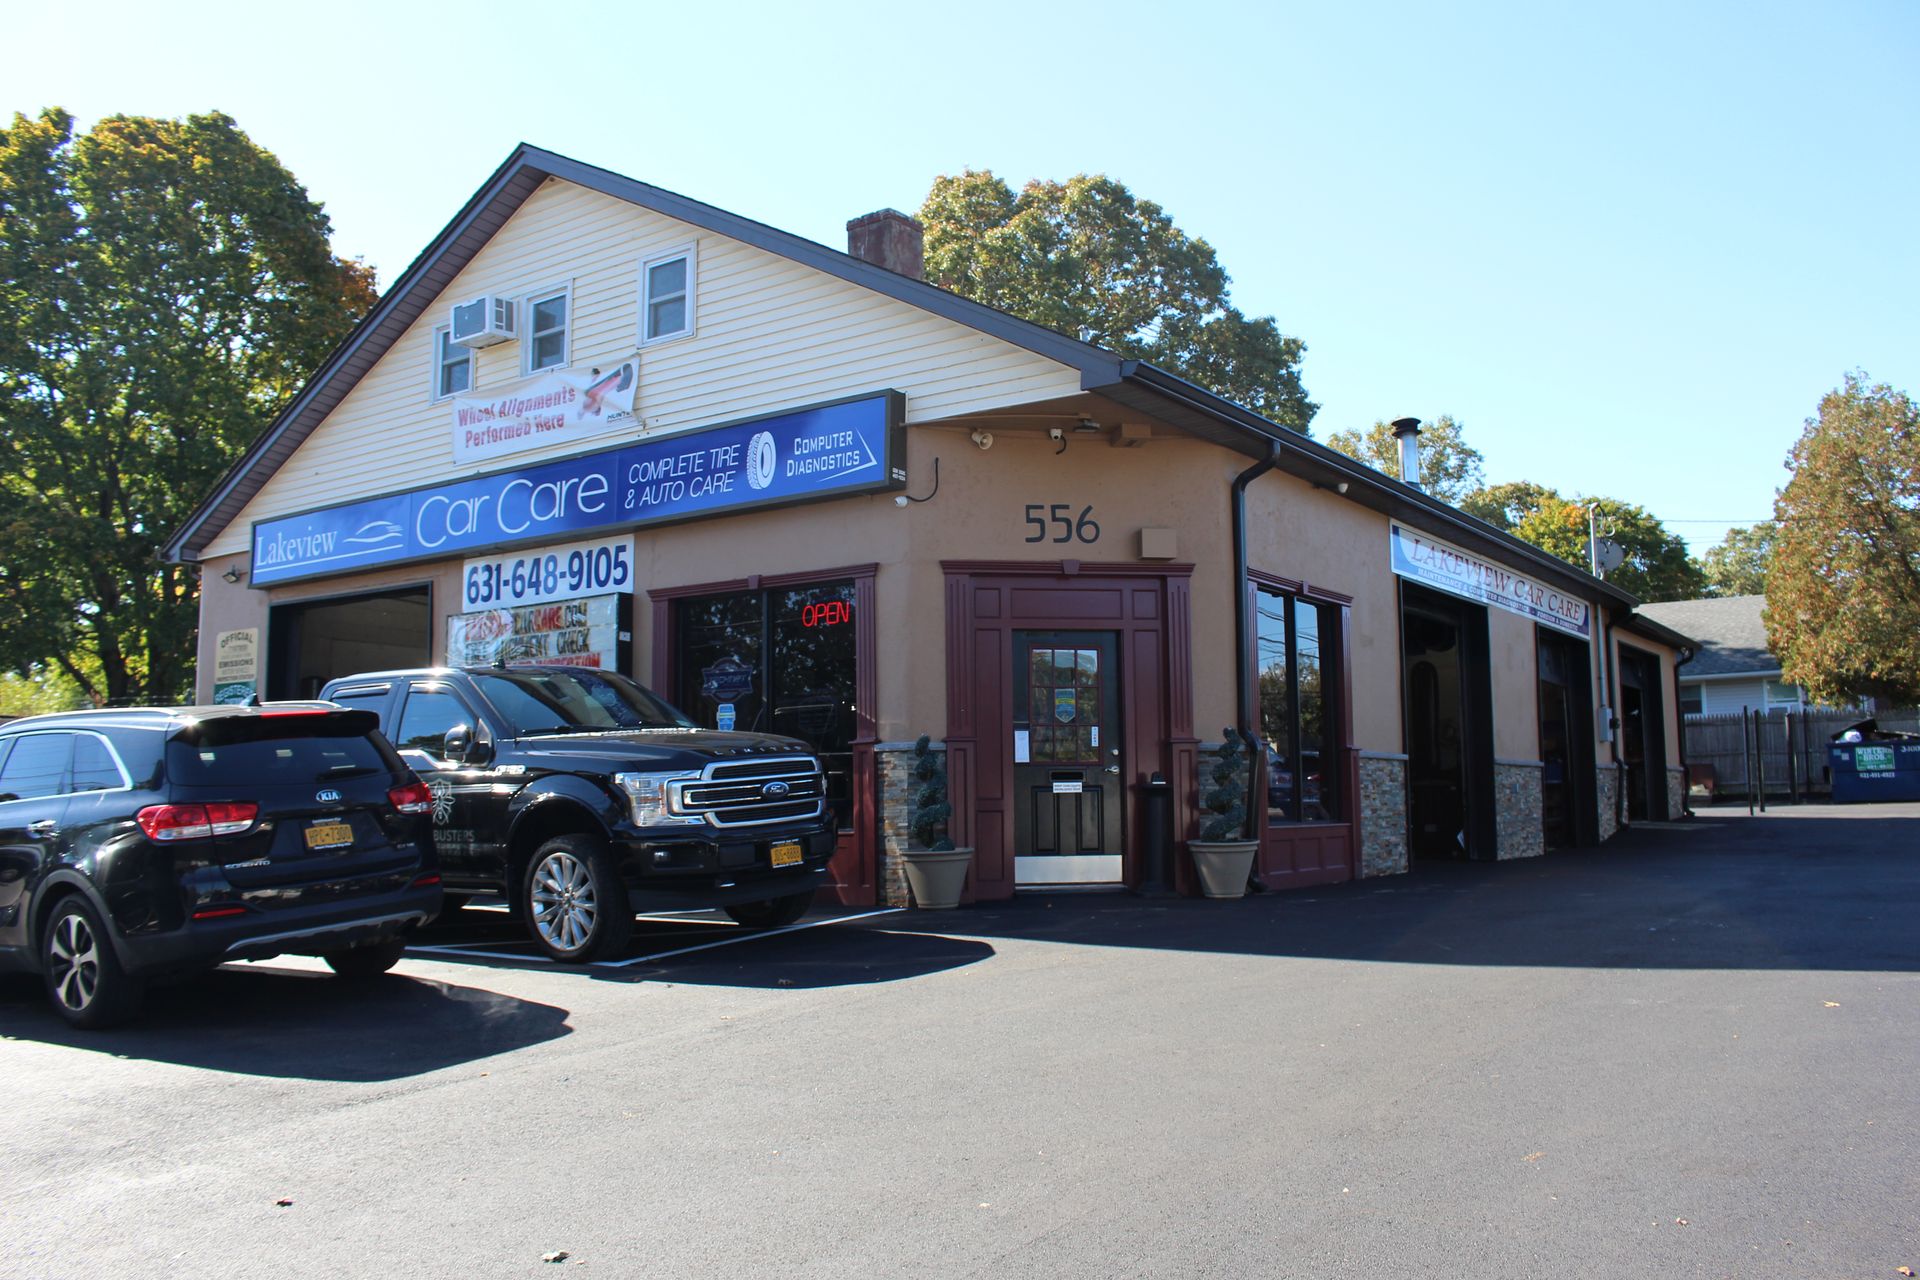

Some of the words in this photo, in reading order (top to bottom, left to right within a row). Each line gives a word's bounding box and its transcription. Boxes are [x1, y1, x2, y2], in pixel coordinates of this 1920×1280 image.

[499, 386, 577, 419] Alignments
[465, 421, 532, 449] Performed
[535, 413, 565, 434] Here
[794, 430, 853, 456] COMPUTER
[628, 450, 705, 485] COMPLETE
[709, 444, 742, 470] TIRE
[786, 450, 861, 478] DIAGNOSTICS
[623, 488, 636, 510] &
[639, 480, 685, 508] AUTO
[689, 470, 736, 499] CARE
[255, 526, 339, 566] Lakeview
[416, 495, 490, 548] Car
[496, 473, 609, 534] Care
[1025, 504, 1100, 544] 556
[466, 544, 629, 605] 631-648-9105
[1411, 538, 1511, 593] LAKEVIEW
[1514, 579, 1545, 609] CAR
[1547, 594, 1581, 622] CARE
[802, 600, 850, 627] OPEN
[221, 632, 253, 648] OFFICIAL
[556, 626, 591, 655] CHECK
[320, 791, 340, 801] KIA
[433, 829, 475, 843] BUSTERS
